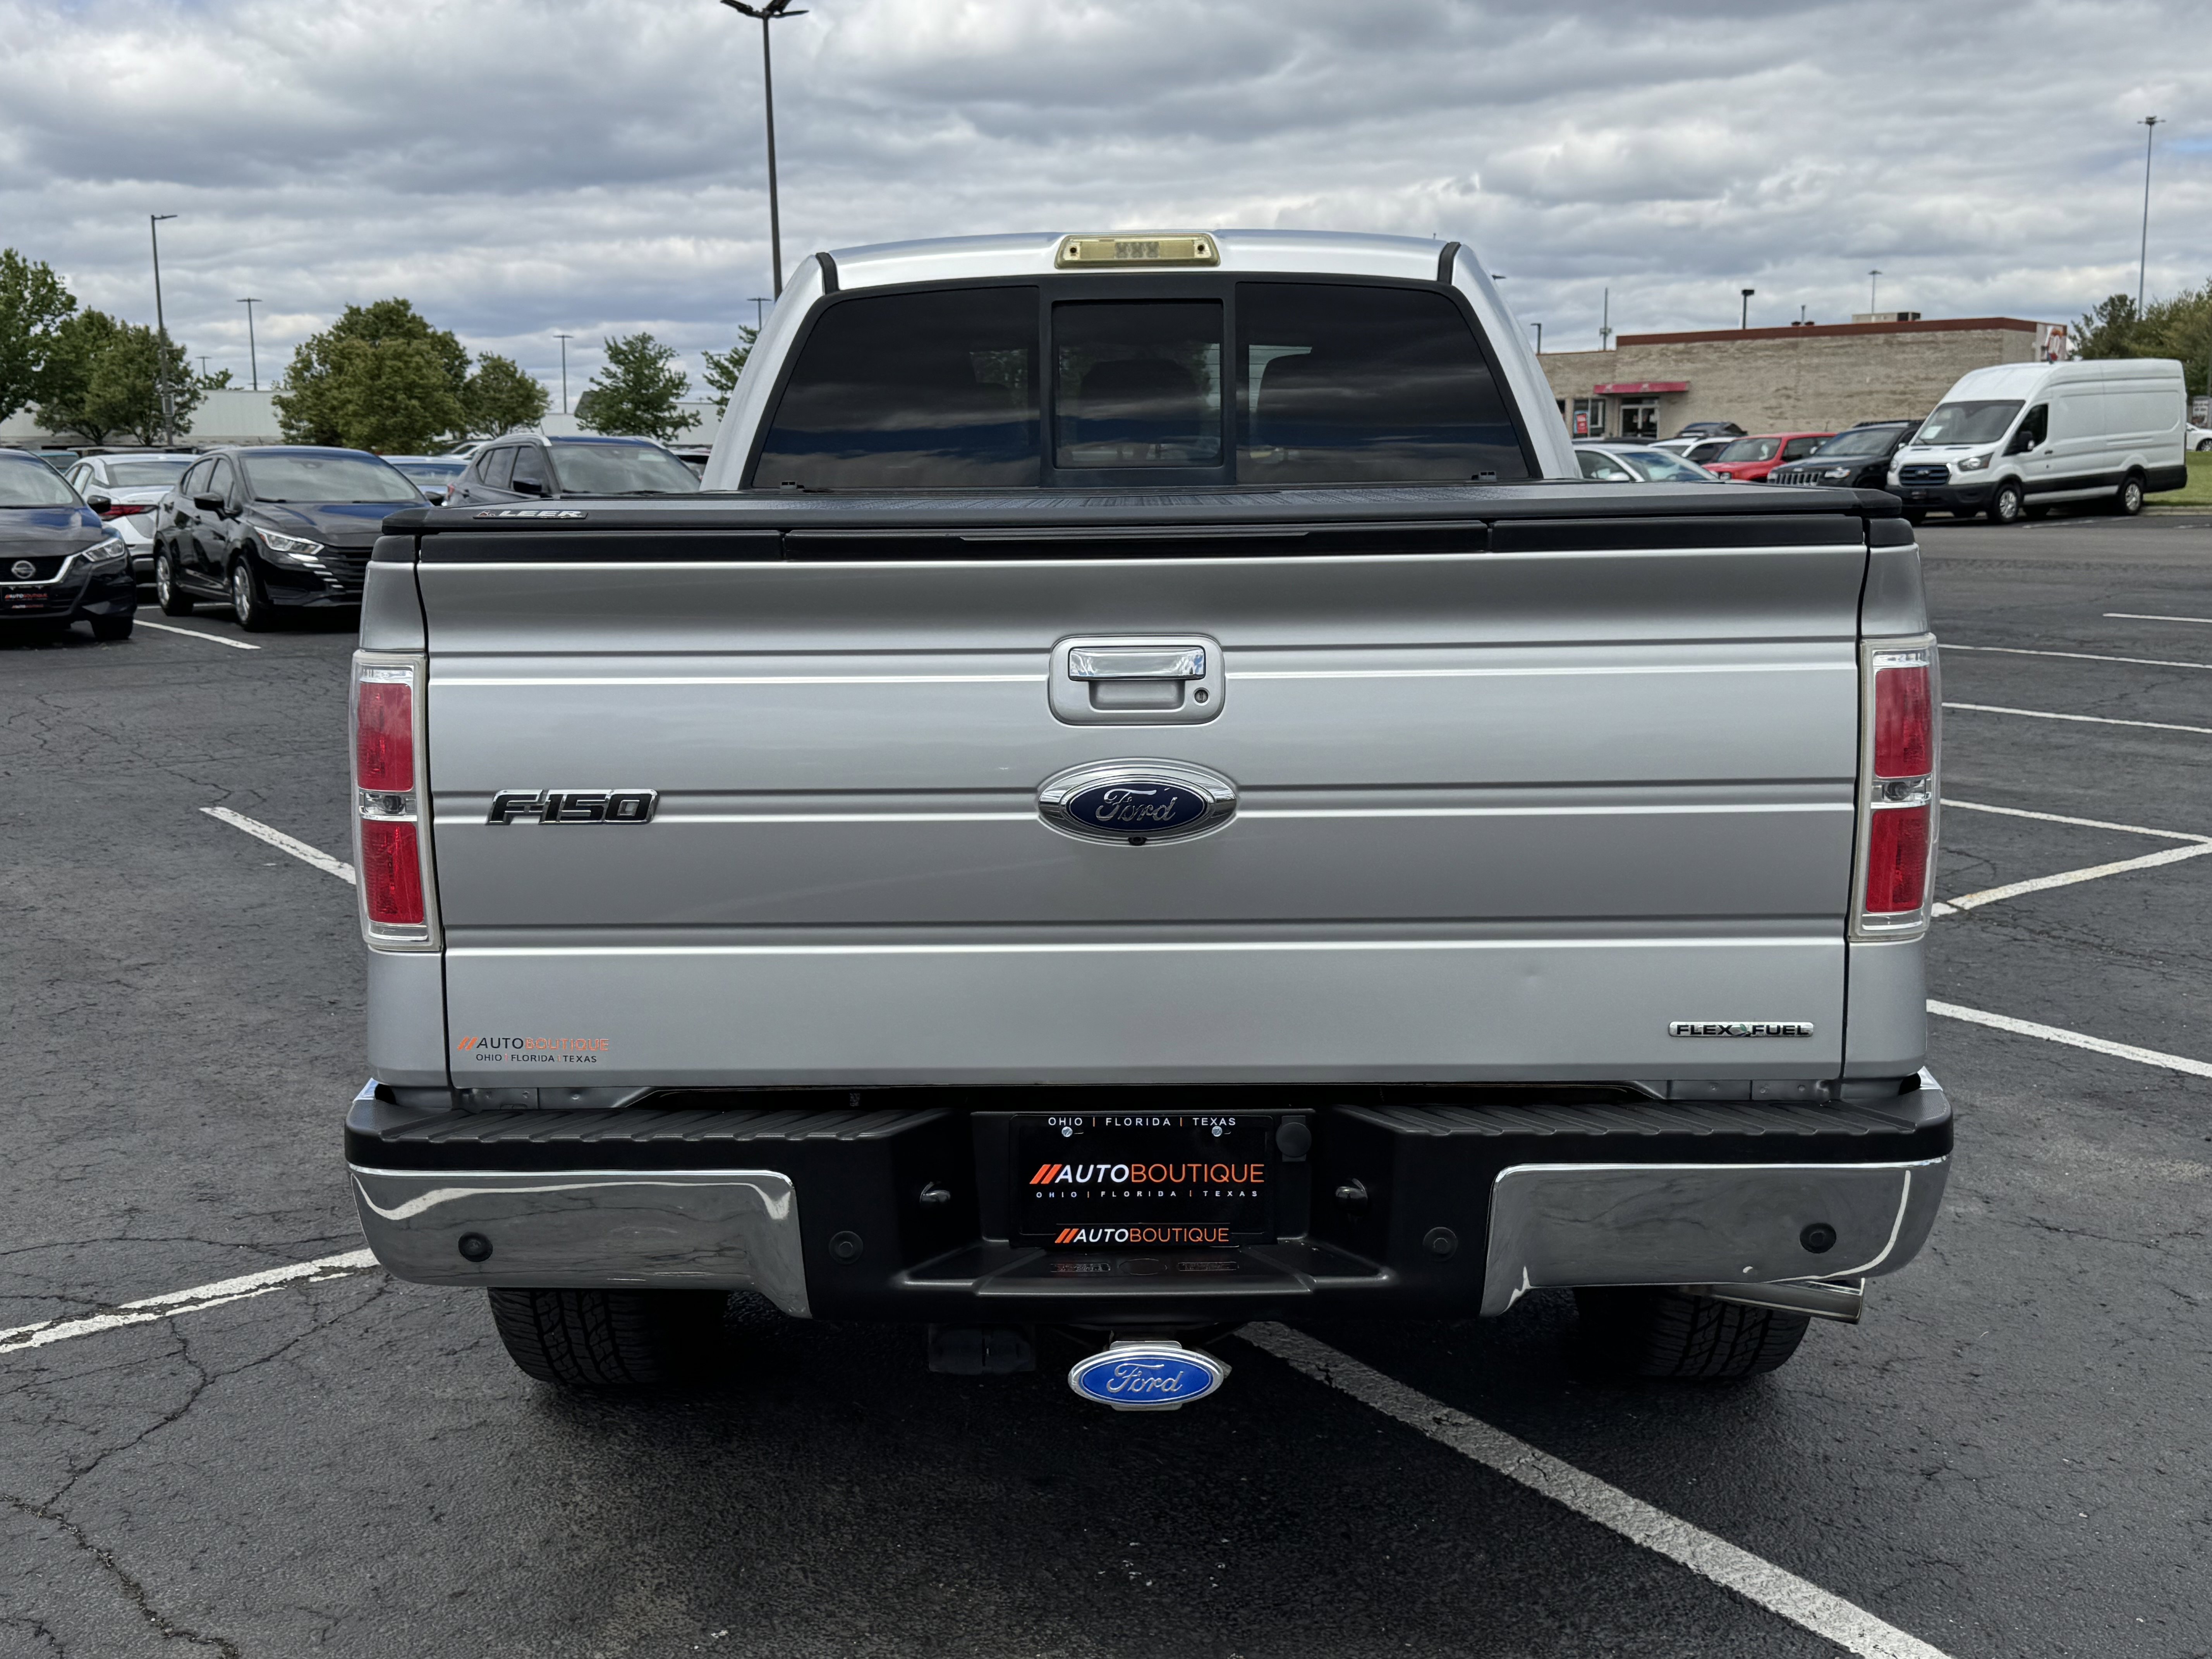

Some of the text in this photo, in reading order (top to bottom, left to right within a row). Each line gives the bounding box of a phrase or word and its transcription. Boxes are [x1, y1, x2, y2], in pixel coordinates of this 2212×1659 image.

[486, 789, 658, 824] F-150
[1096, 788, 1178, 821] Ford
[1676, 1025, 1810, 1035] FLEX FUEL
[476, 1037, 610, 1051] AUTOBOUTIQUE
[1048, 1117, 1236, 1126] OHIO FLORIDA TEXAS
[1055, 1164, 1265, 1183] AUTOBOUTIQUE
[1073, 1228, 1230, 1243] AUTOBOUTIQUE
[1106, 1363, 1184, 1393] Ford
